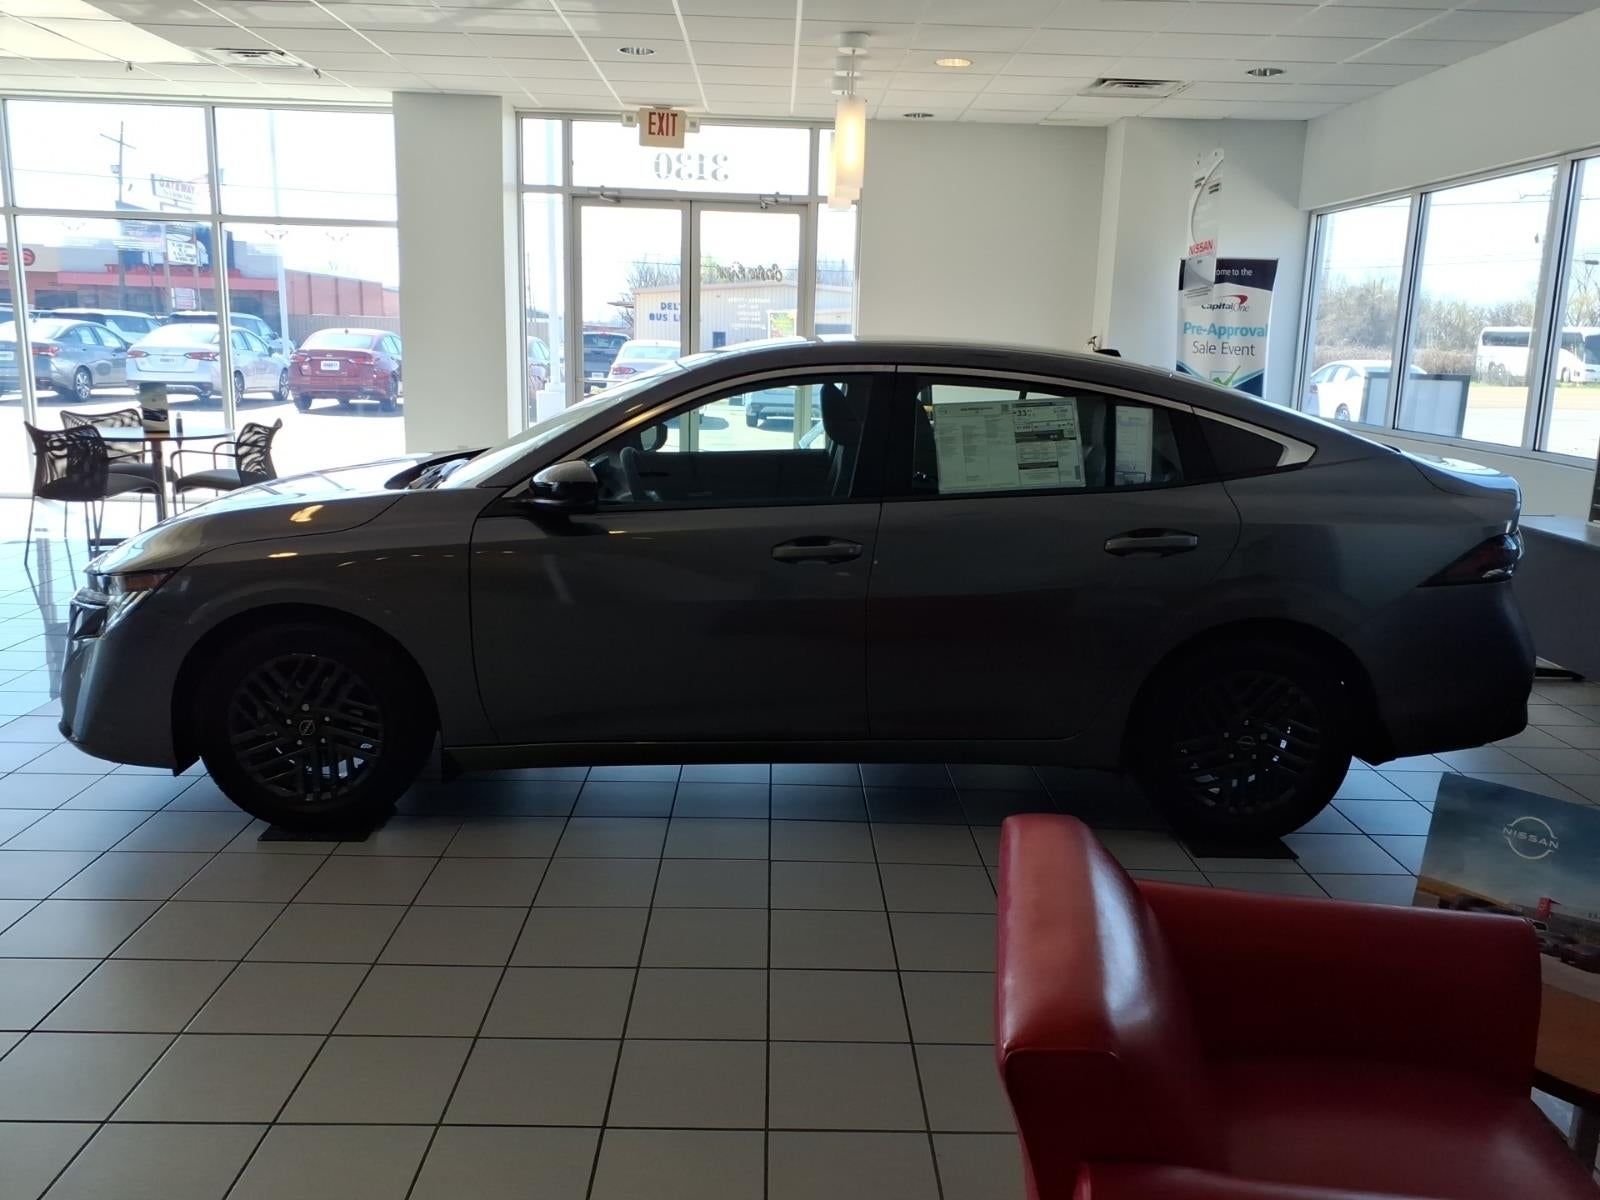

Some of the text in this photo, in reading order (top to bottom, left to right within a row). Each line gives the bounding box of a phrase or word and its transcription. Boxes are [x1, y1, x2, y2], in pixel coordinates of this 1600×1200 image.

[648, 111, 678, 137] EXIT
[1188, 240, 1214, 256] NISSAN
[1232, 268, 1239, 276] to
[1241, 267, 1253, 276] the
[660, 302, 680, 311] DEL
[1183, 322, 1268, 339] Pre-Approval
[1192, 341, 1256, 357] Sale Event
[1503, 827, 1559, 849] NISSAN
